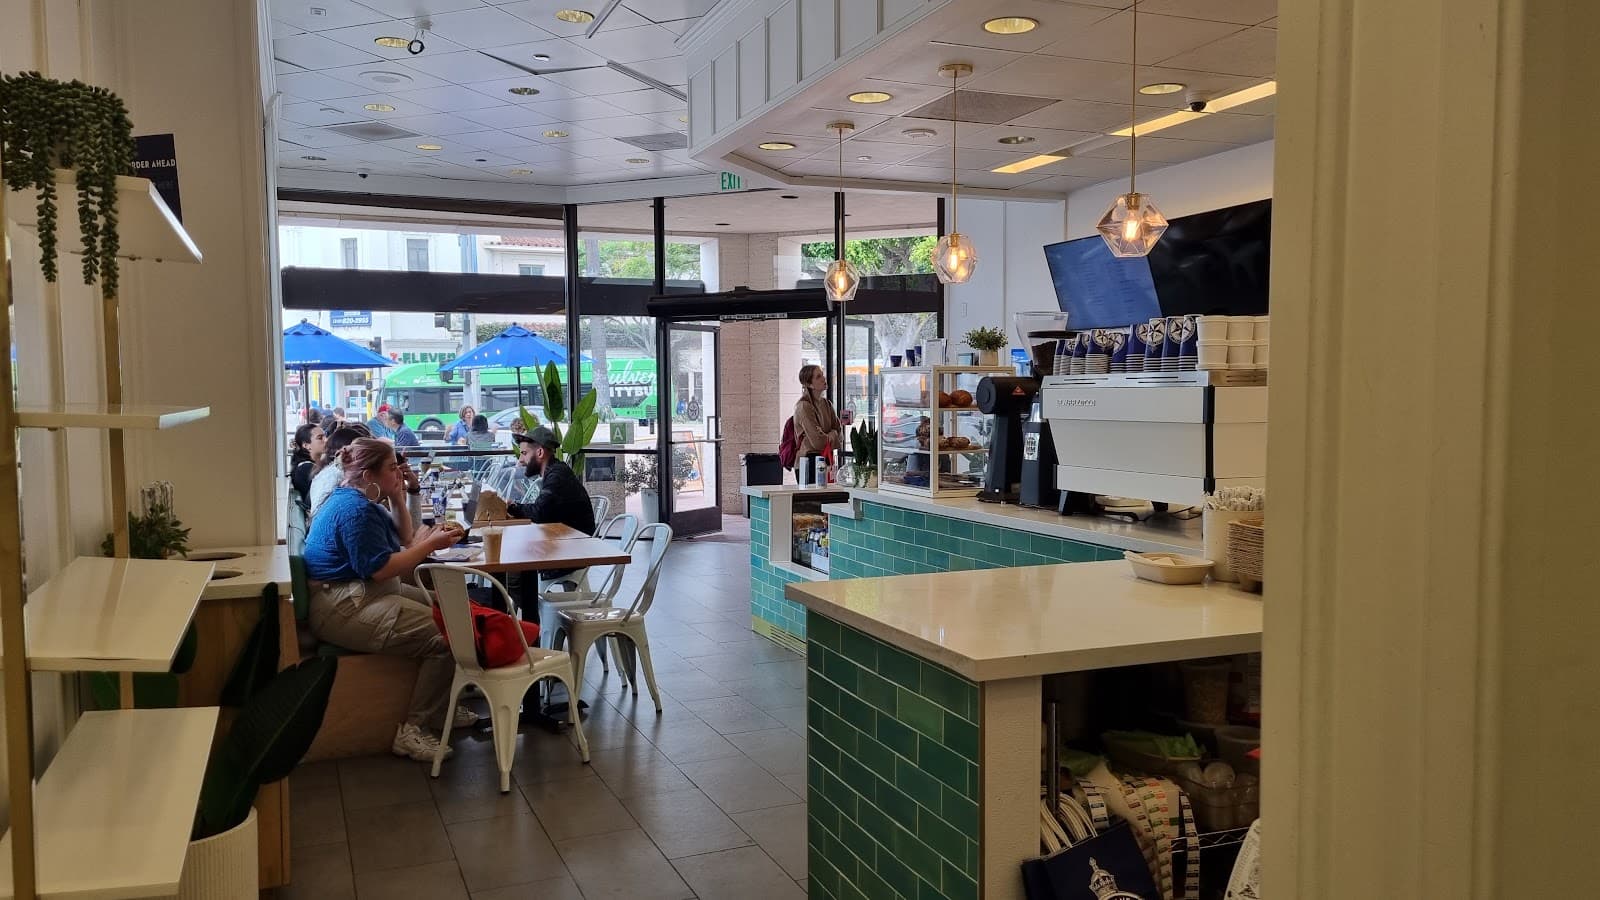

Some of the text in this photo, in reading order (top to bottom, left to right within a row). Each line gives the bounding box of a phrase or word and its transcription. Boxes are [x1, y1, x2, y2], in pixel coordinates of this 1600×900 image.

[151, 159, 176, 168] AHEAD
[721, 171, 741, 190] EXIT
[607, 360, 657, 384] ulver
[609, 386, 656, 397] ITYBU
[613, 427, 624, 441] A
